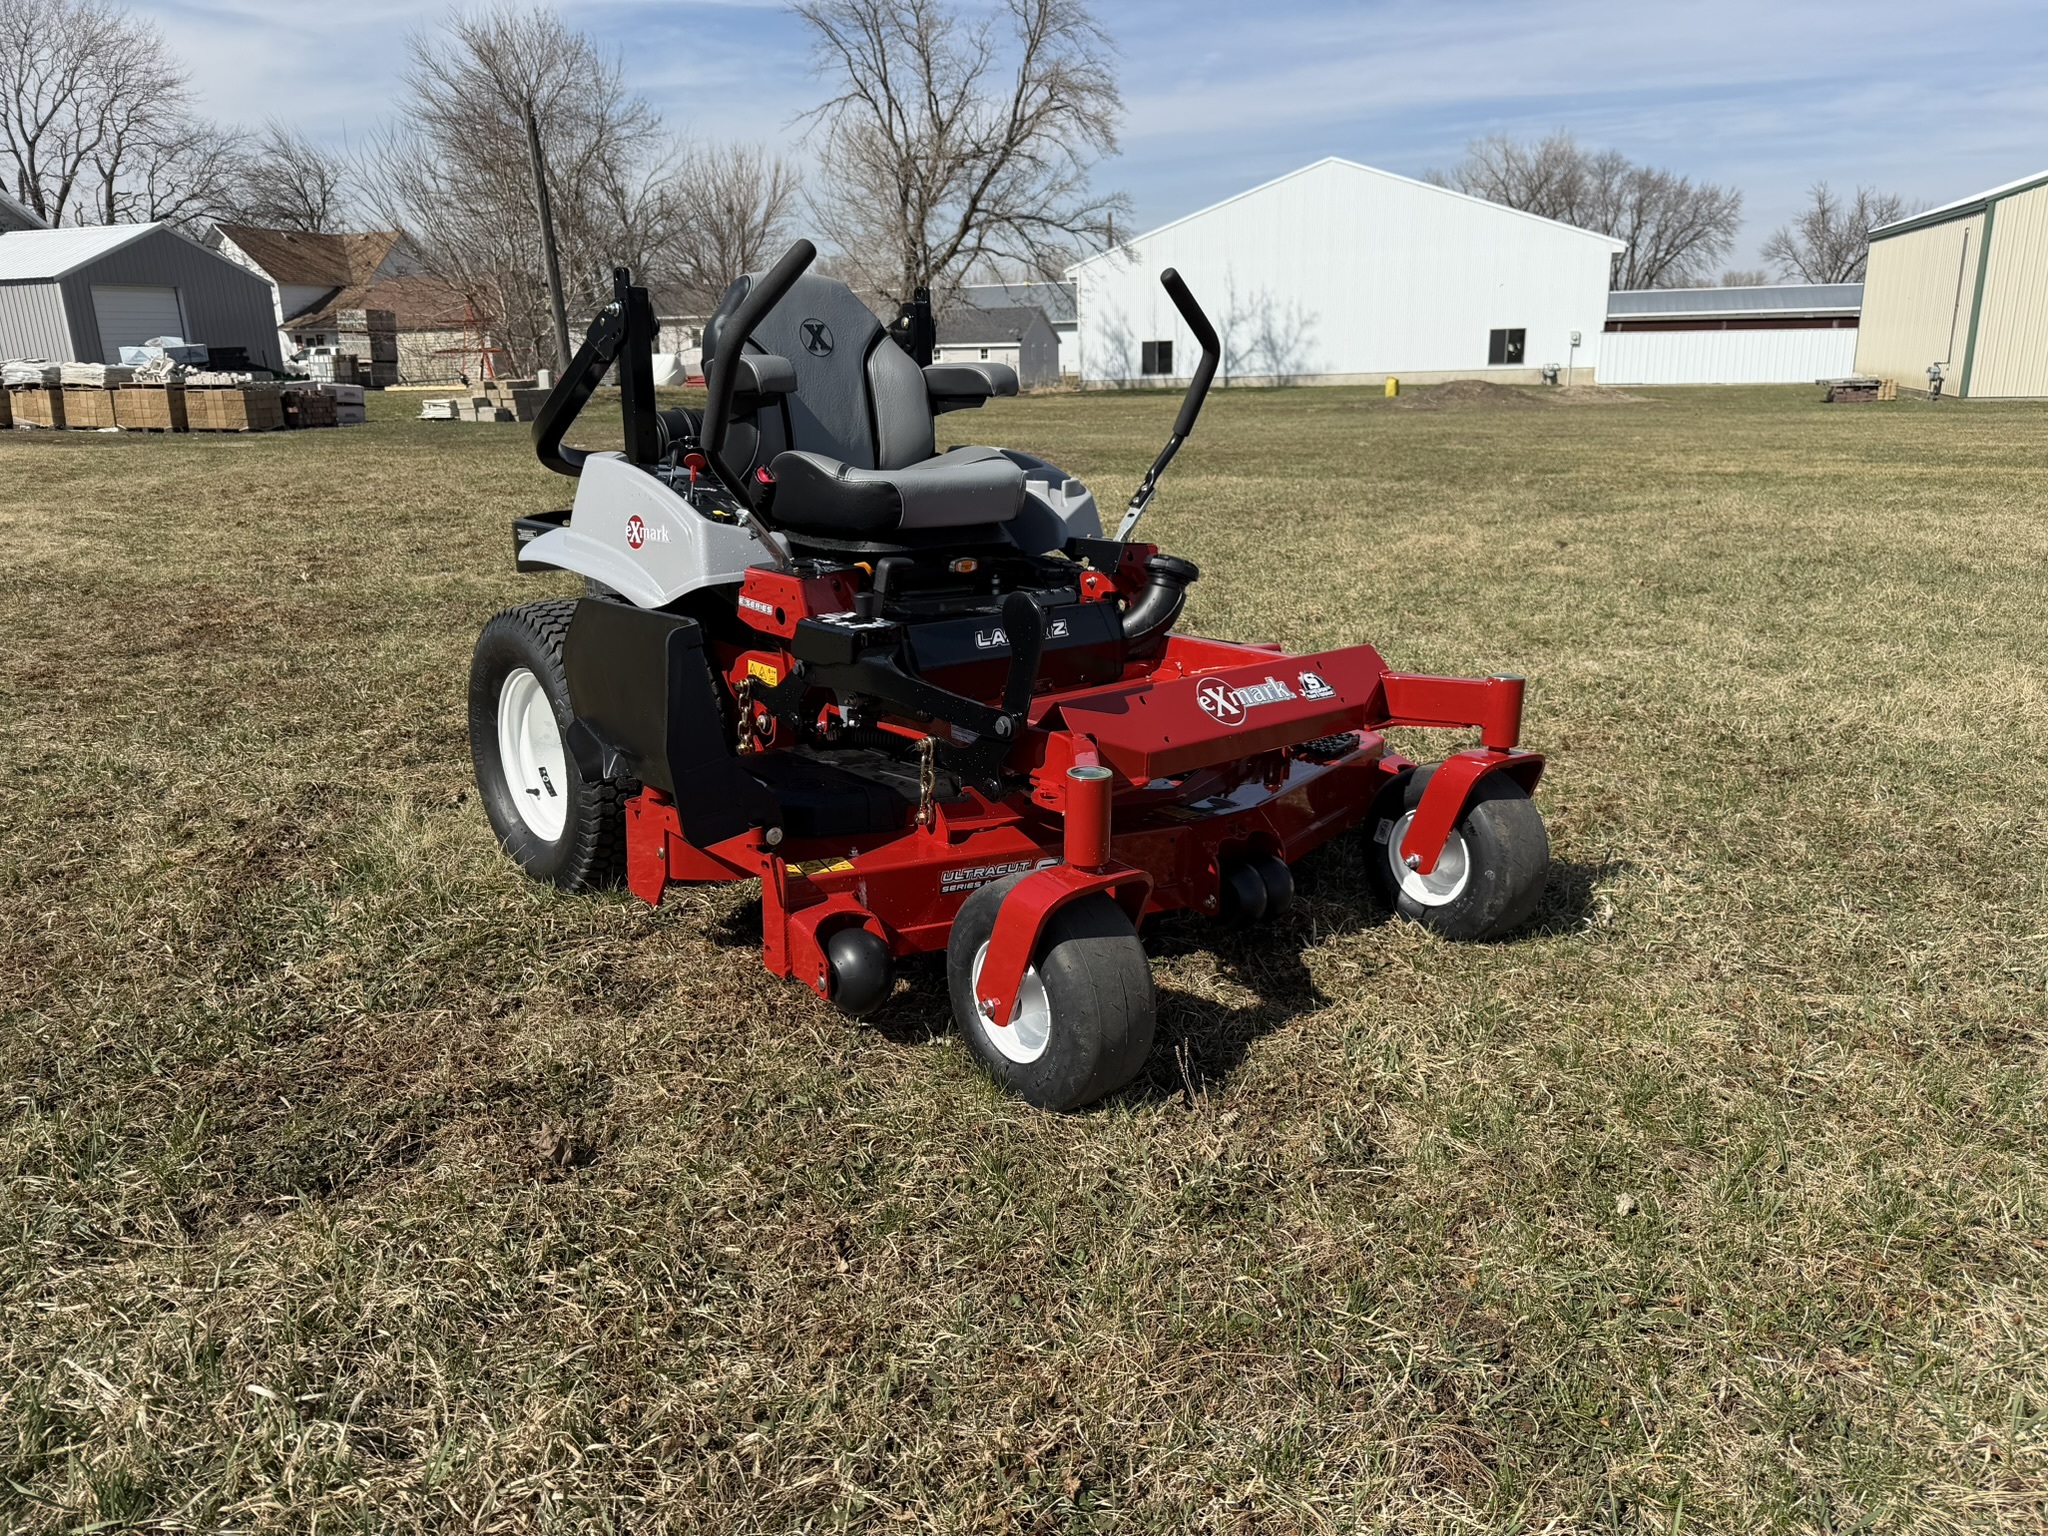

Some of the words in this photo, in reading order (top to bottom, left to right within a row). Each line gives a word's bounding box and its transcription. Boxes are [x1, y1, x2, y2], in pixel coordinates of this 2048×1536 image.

[804, 323, 831, 350] X
[625, 520, 670, 544] eXmark
[1198, 677, 1291, 717] eXmark
[941, 860, 1032, 883] ULTRACUT
[941, 881, 982, 893] SERIES
